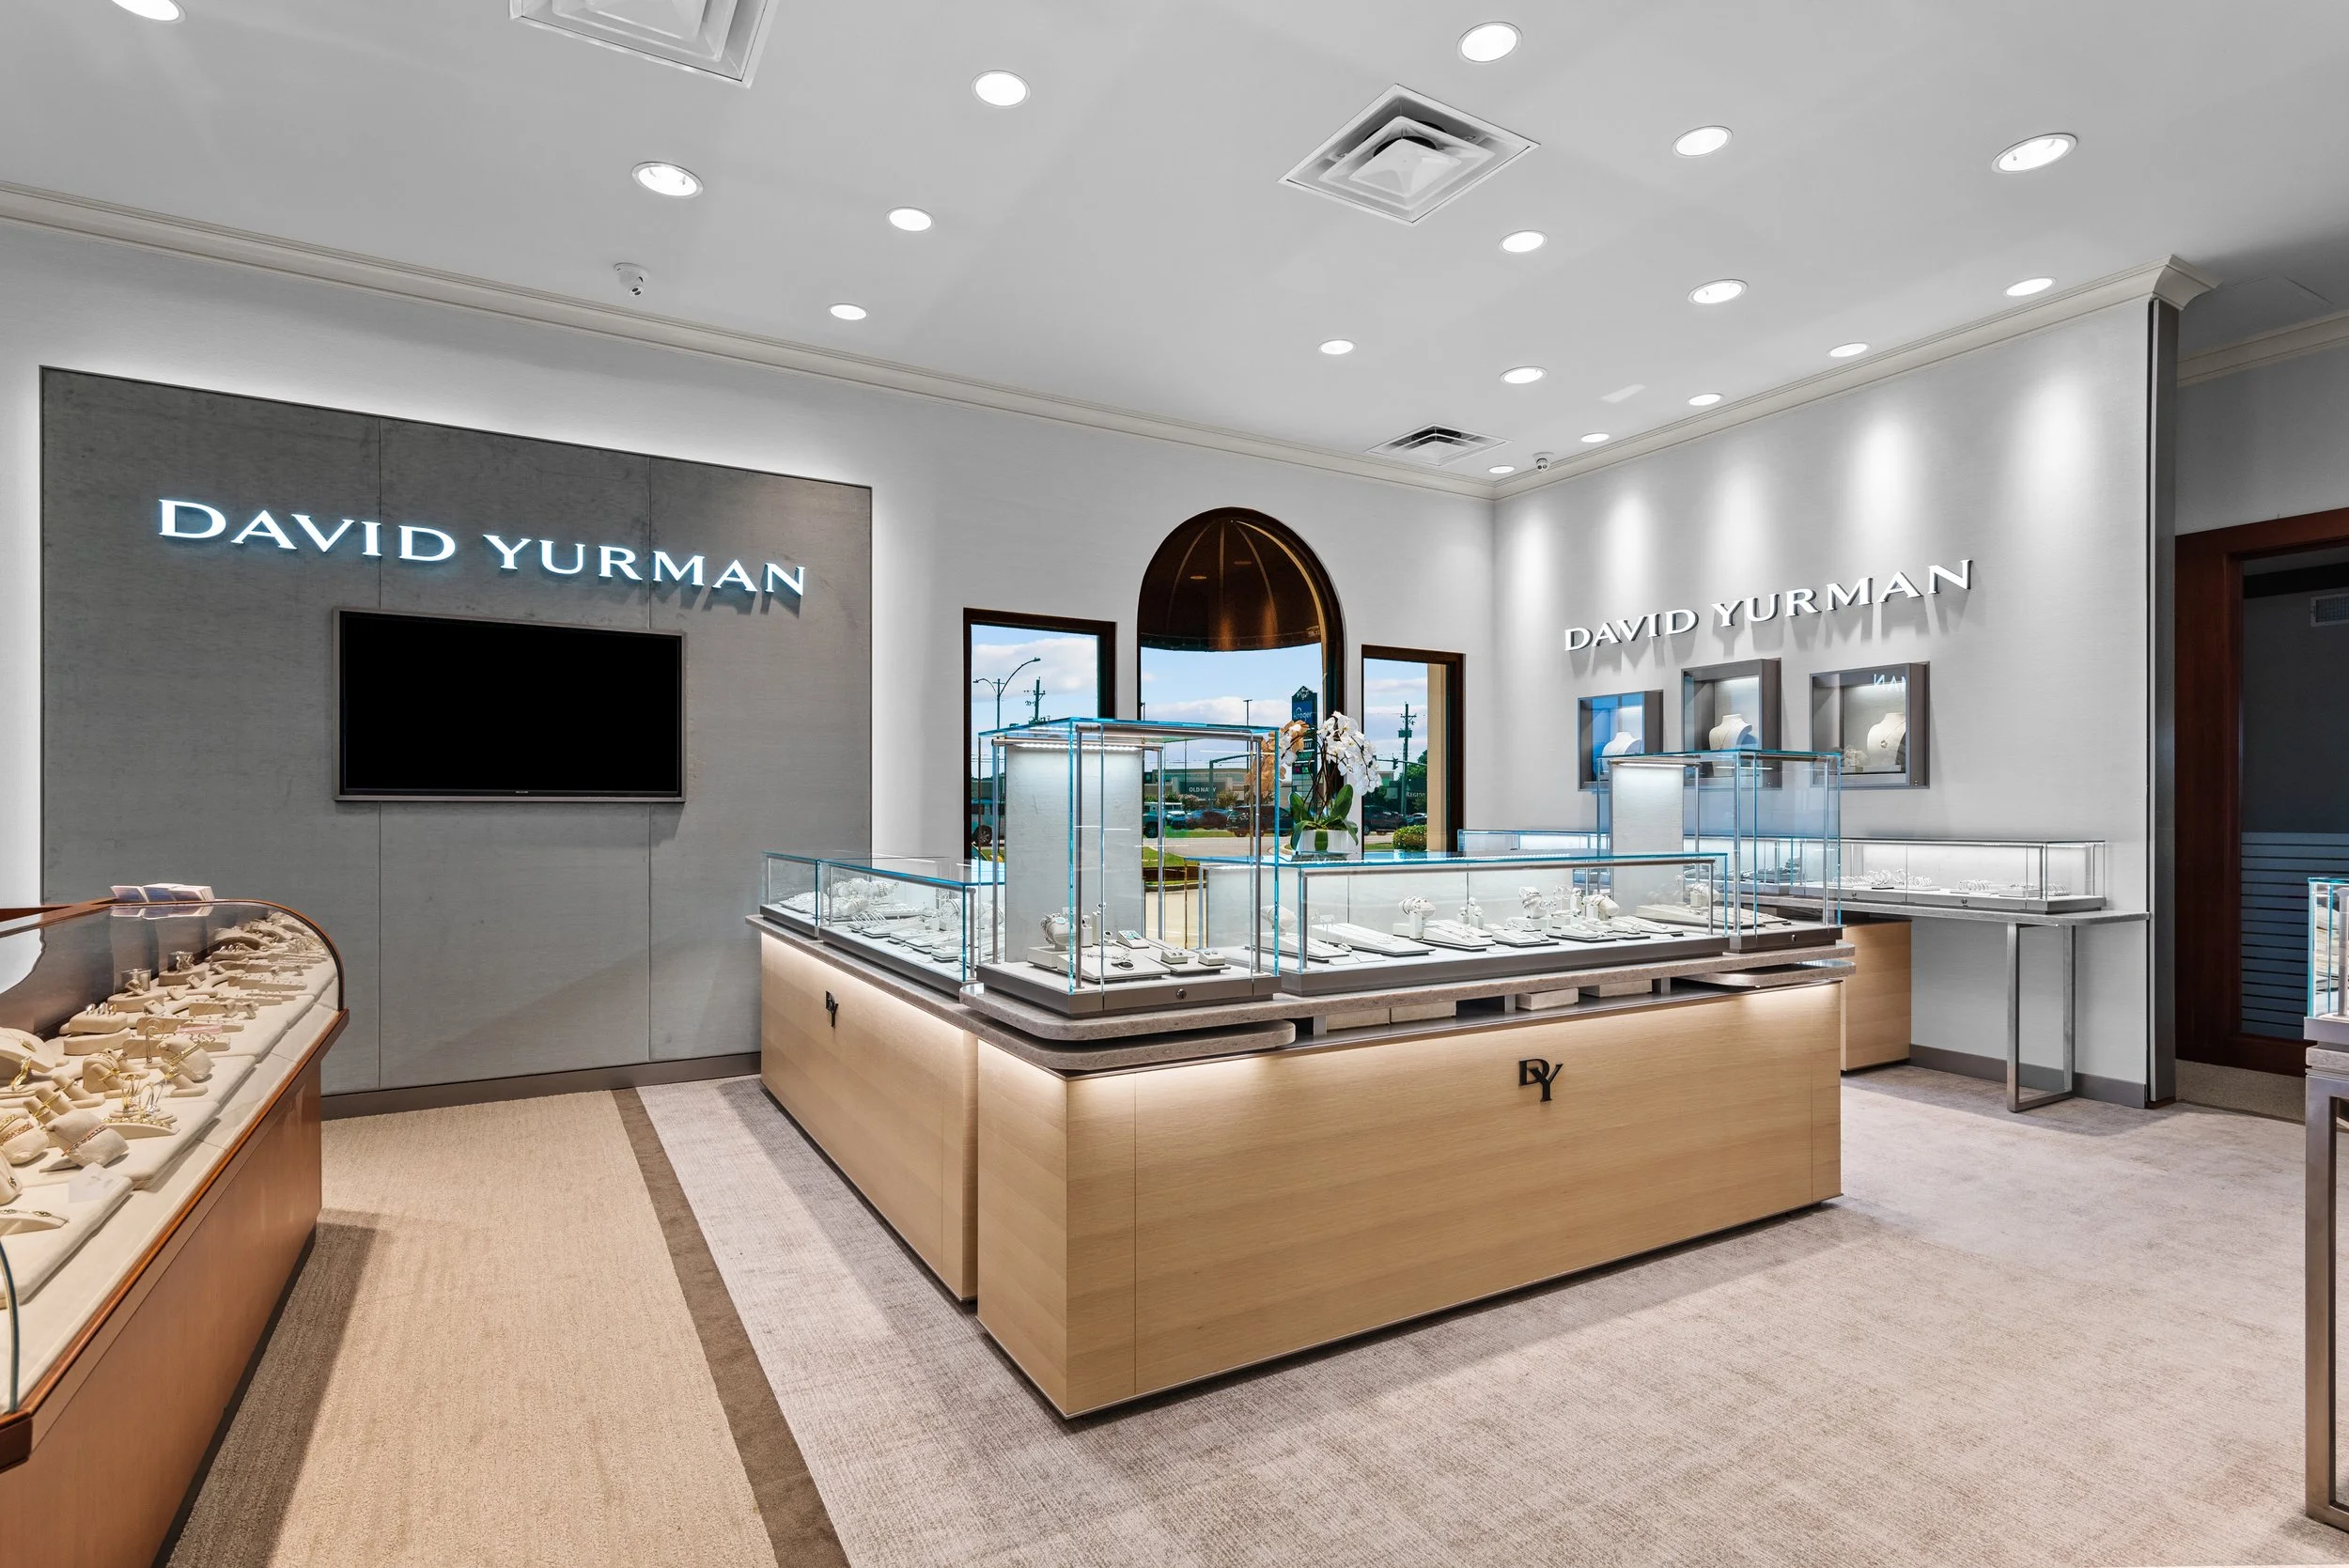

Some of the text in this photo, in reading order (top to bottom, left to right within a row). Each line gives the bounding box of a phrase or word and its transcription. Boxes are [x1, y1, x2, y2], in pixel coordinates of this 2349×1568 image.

[158, 498, 806, 597] DAVID YURMAN
[1563, 558, 1972, 652] DAVID YURMAN
[1517, 1058, 1564, 1103] DY
